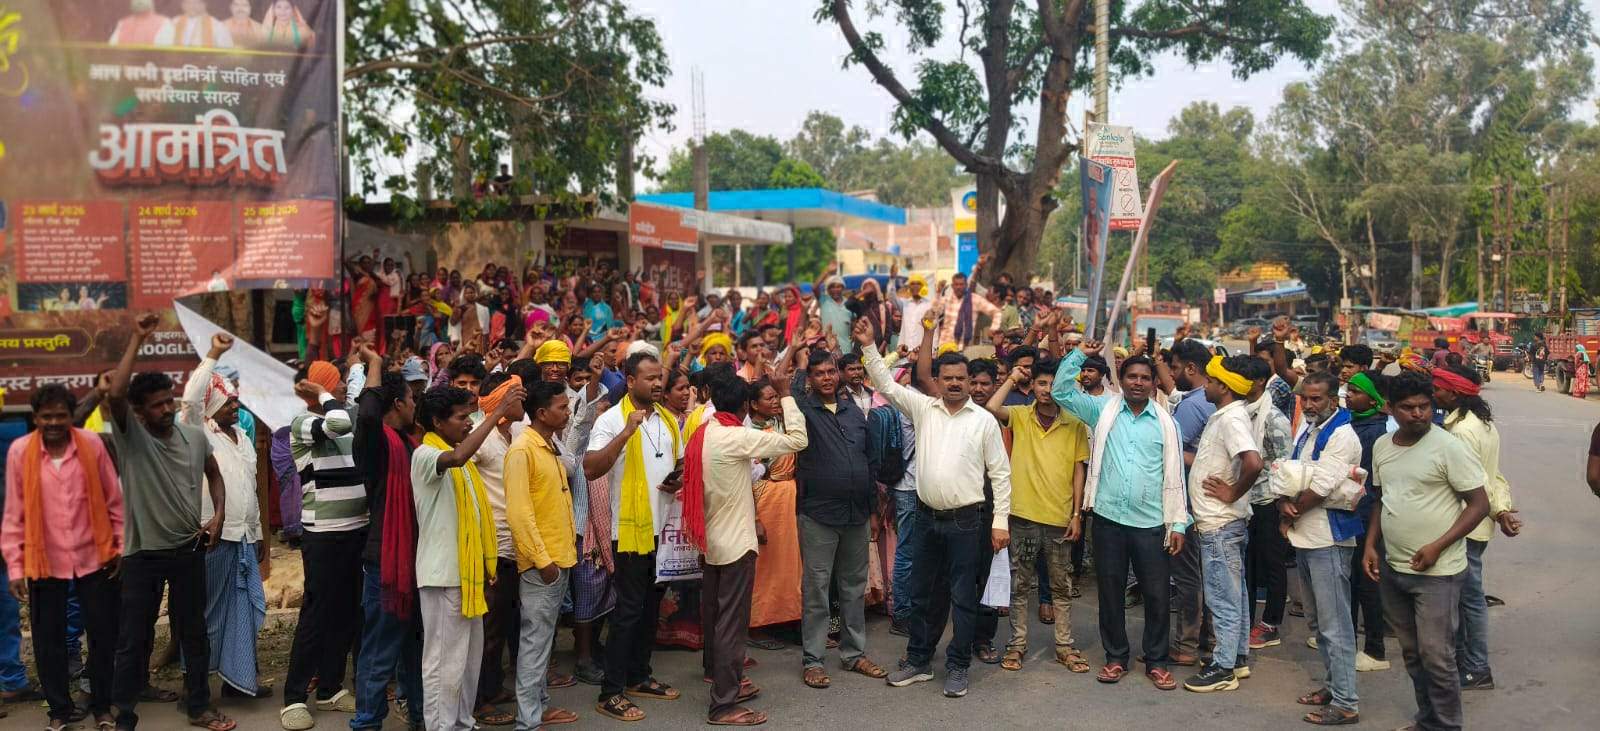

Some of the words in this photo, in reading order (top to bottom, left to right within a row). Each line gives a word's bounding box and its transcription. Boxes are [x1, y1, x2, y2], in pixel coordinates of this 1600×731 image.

[90, 63, 121, 80] आप
[125, 62, 158, 81] सभी
[161, 64, 217, 86] इष्टमित्रों
[221, 67, 259, 86] सहित
[263, 68, 286, 87] एवं
[135, 84, 199, 103] सपरिवार
[203, 90, 241, 106] सादर
[88, 108, 287, 176] आमंत्रित
[139, 206, 151, 216] 24
[153, 203, 172, 216] मार्च
[174, 206, 198, 216] 2026
[243, 207, 256, 216] 25
[258, 203, 275, 216] मार्च
[275, 205, 298, 215] 2026
[23, 334, 71, 351] प्रस्तुति
[137, 343, 195, 356] OOGLE
